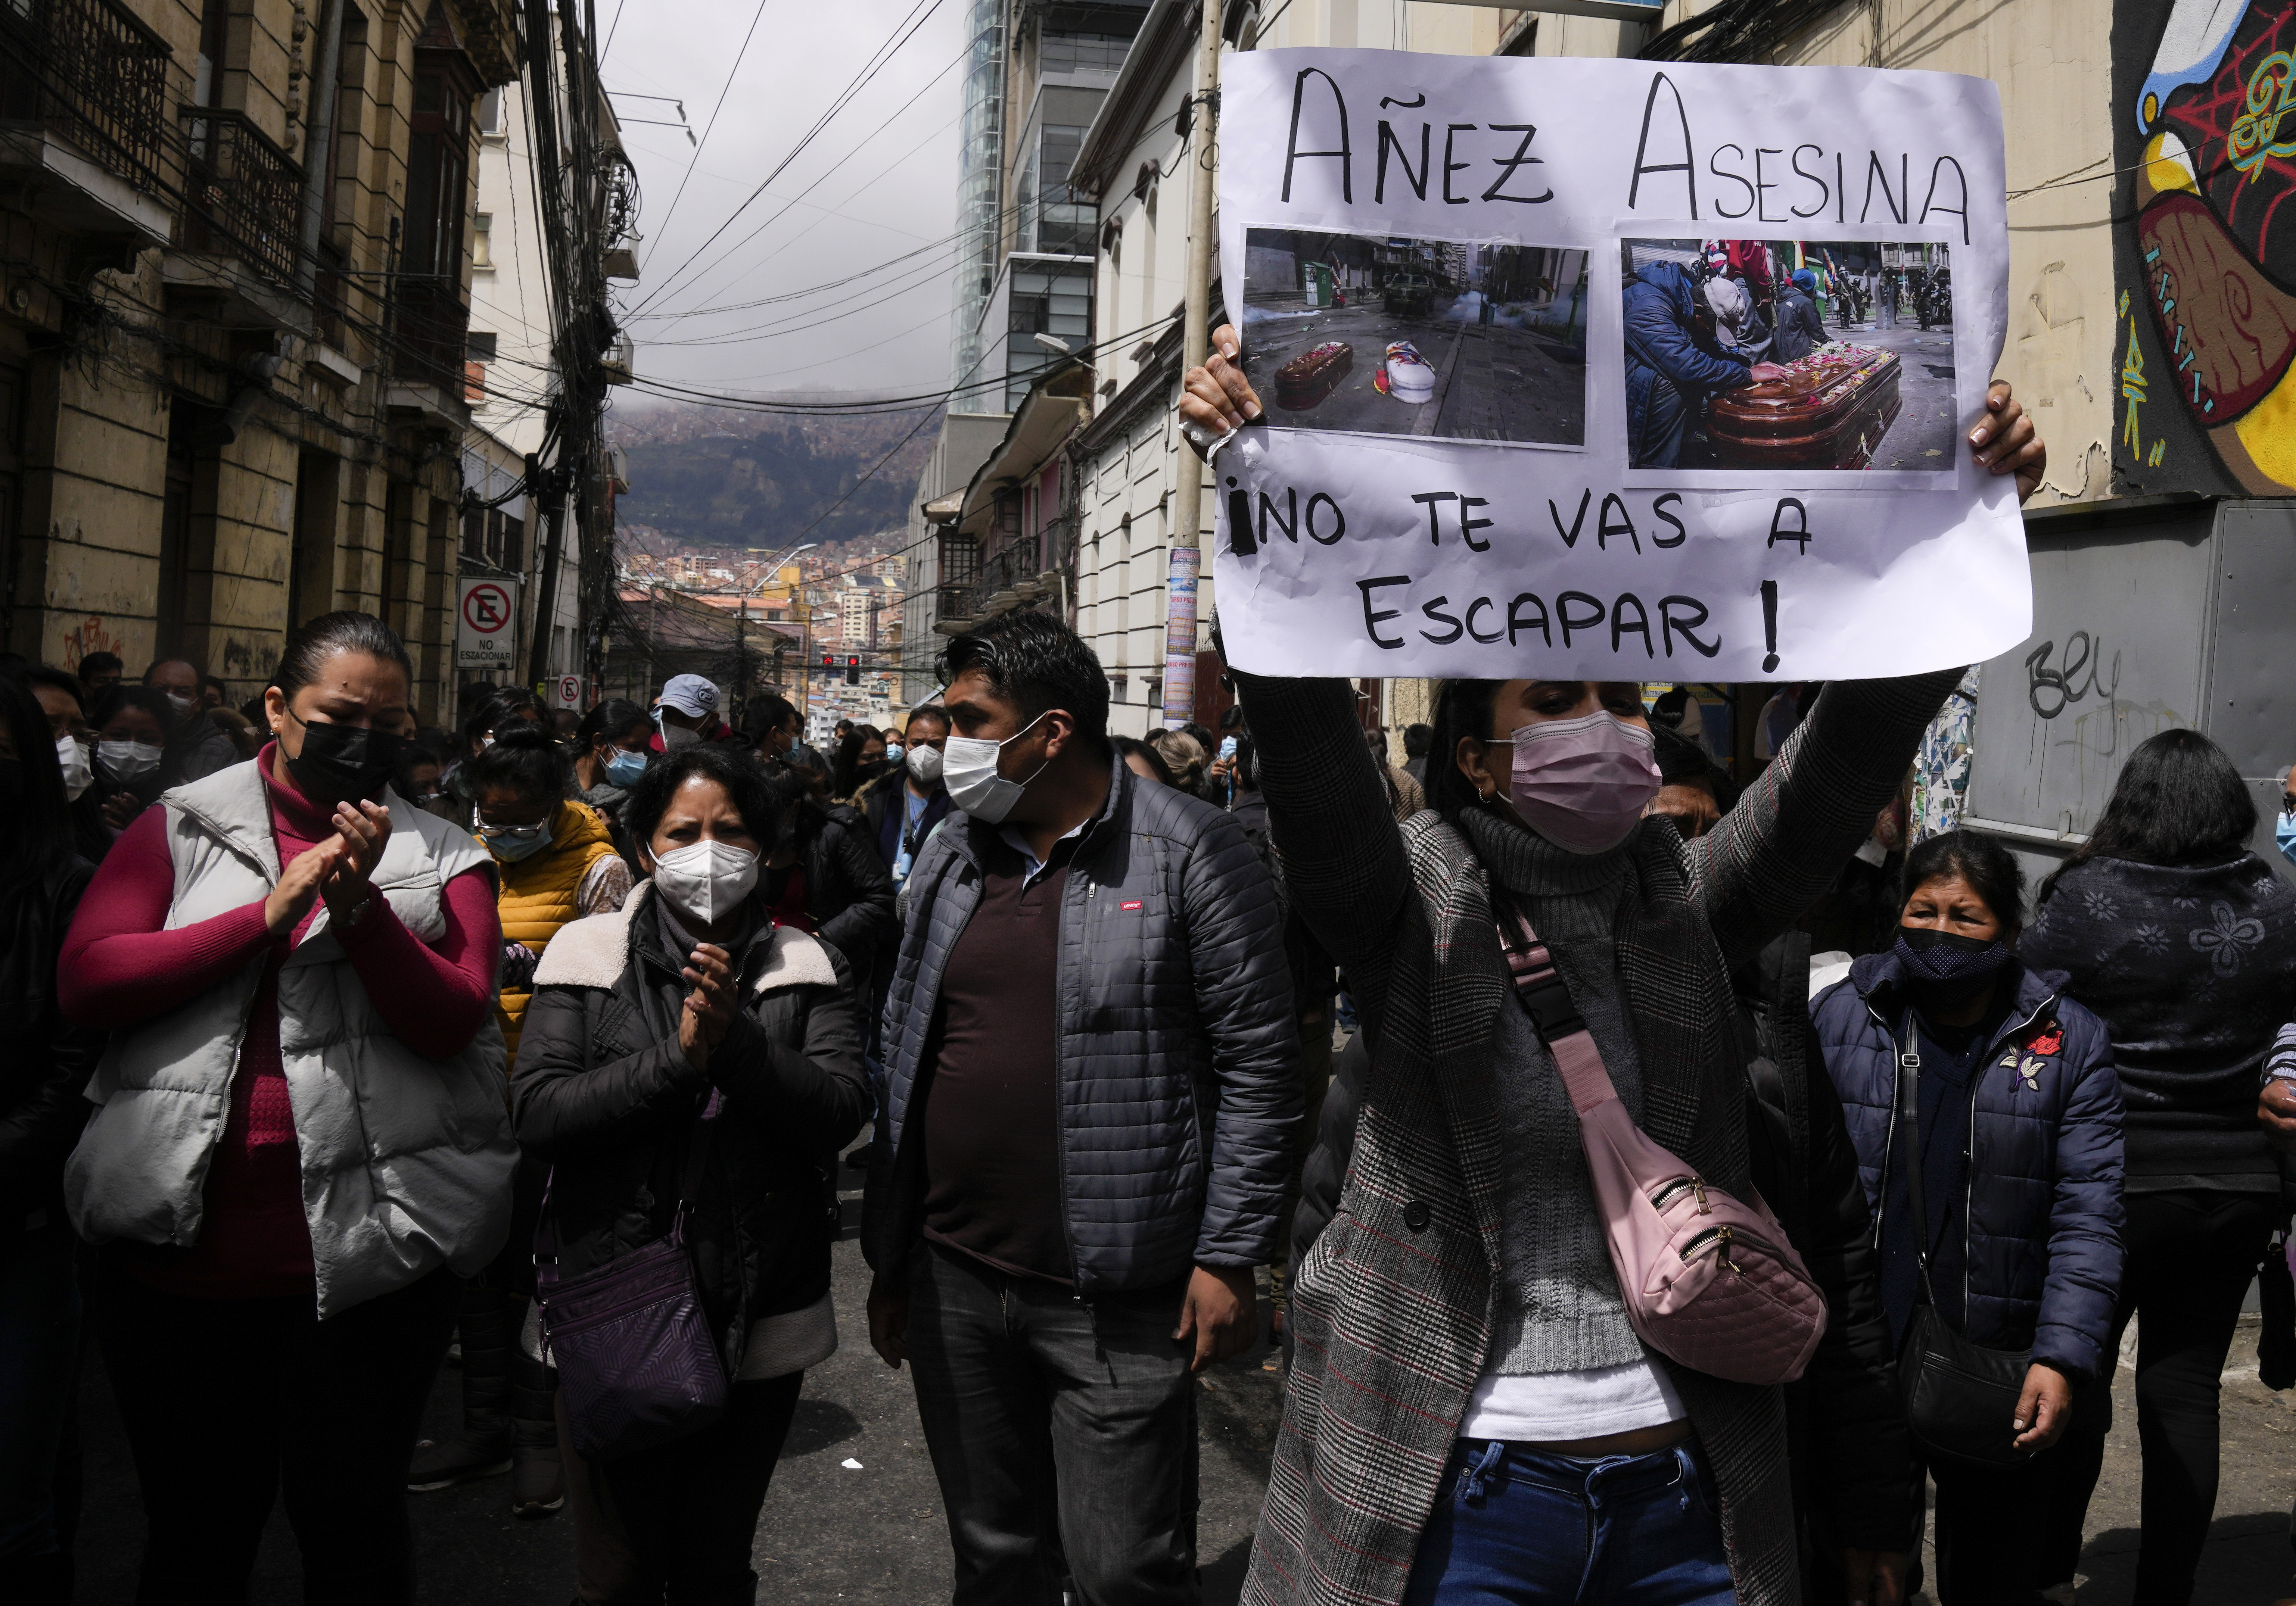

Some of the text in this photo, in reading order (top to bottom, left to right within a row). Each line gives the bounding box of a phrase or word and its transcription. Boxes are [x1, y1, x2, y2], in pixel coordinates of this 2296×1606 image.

[1281, 67, 1970, 245] AÑEZ ASESINA
[1411, 492, 1494, 552] TE
[1549, 488, 1686, 555] VAS
[1767, 497, 1812, 556] A
[460, 651, 510, 661] ESTACIONAR
[479, 640, 493, 650] NO
